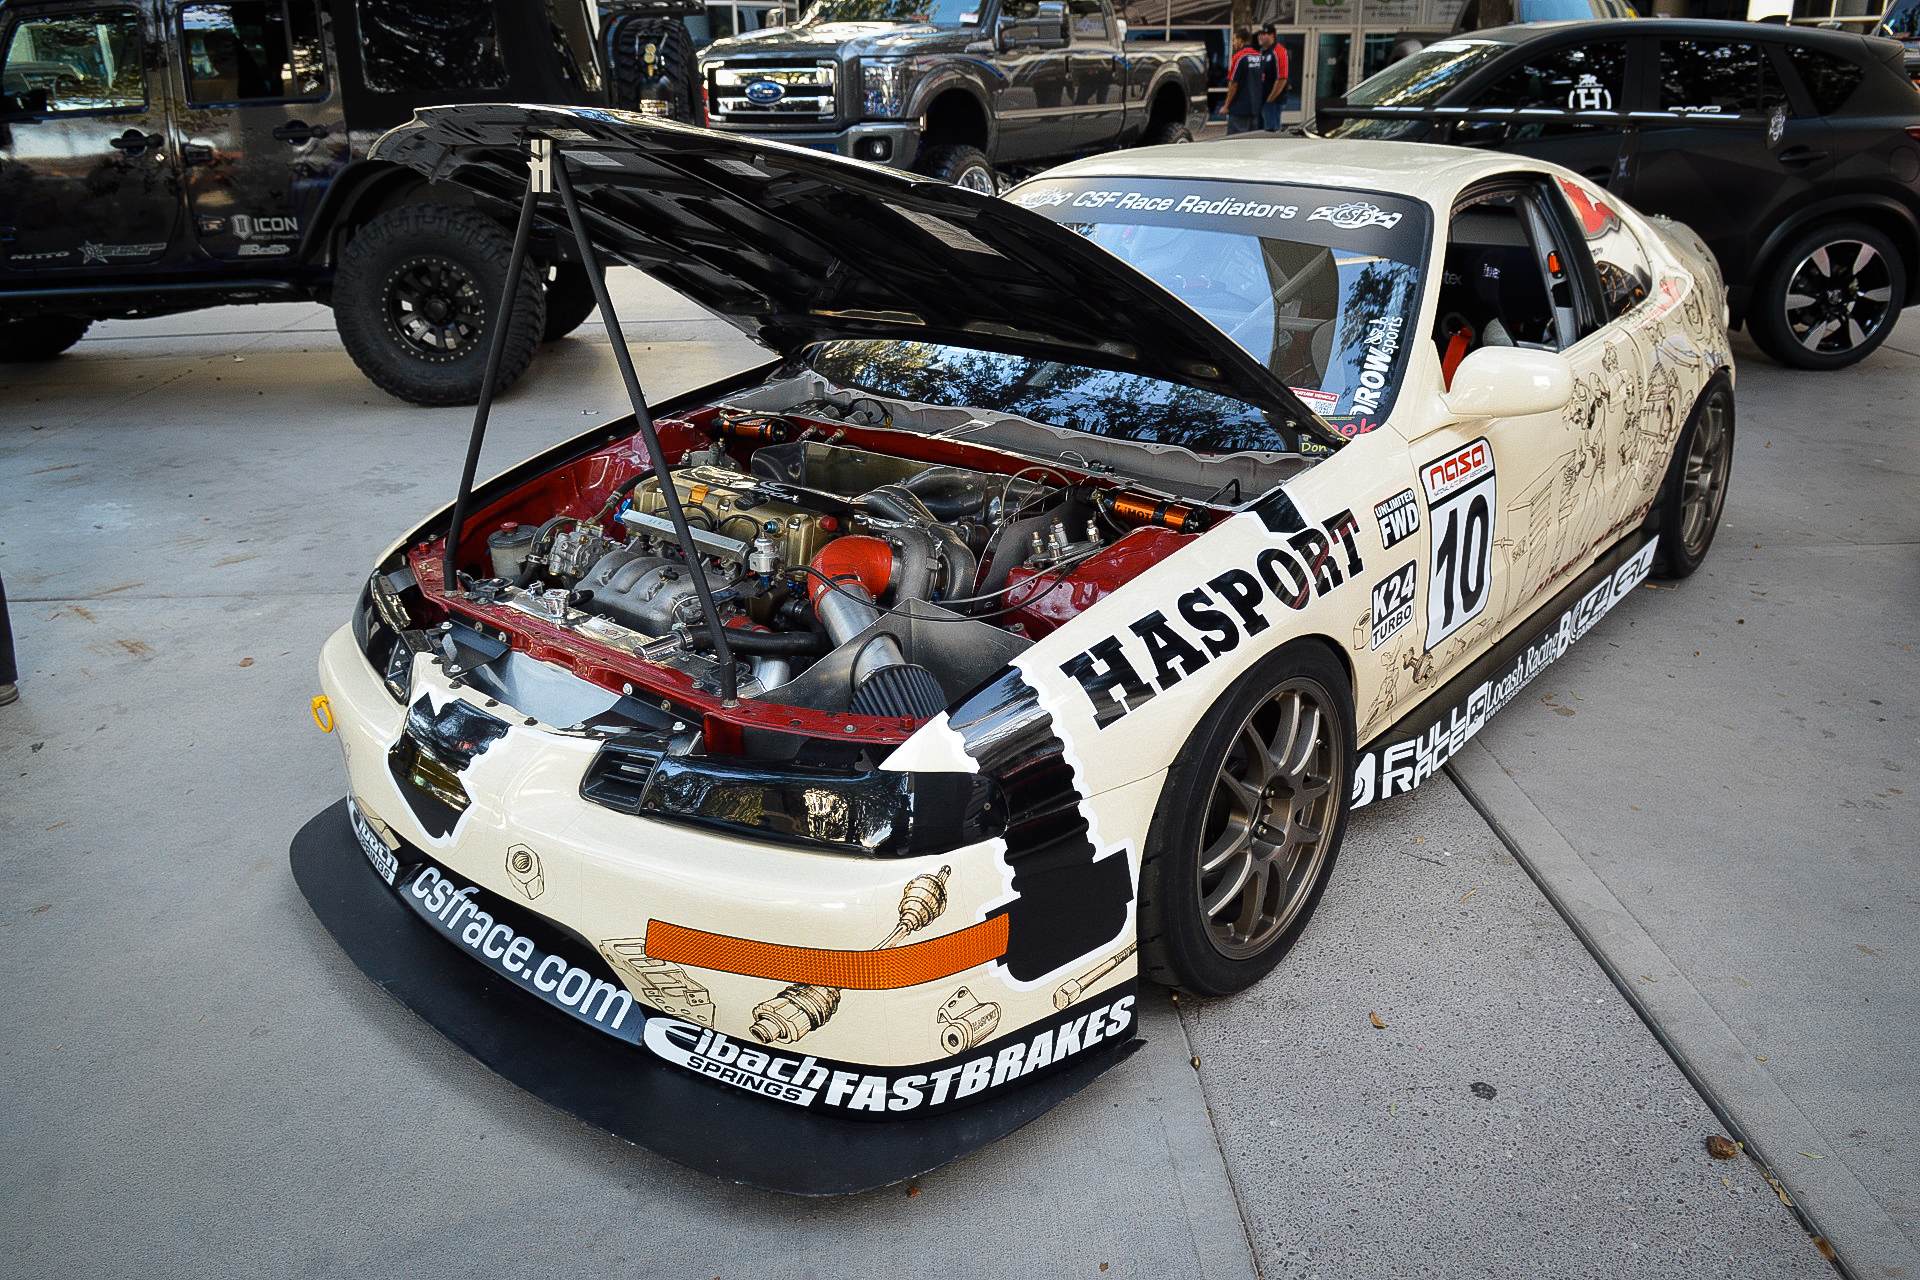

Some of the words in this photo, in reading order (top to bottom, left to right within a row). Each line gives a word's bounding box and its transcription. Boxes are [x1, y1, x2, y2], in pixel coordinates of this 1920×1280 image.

[253, 217, 298, 232] ICON
[1072, 191, 1123, 208] CSF
[1115, 192, 1175, 211] Race
[1175, 194, 1299, 219] Radiators
[1383, 316, 1403, 355] sports
[1430, 443, 1485, 490] nasa
[1375, 489, 1414, 518] UNLIMITED
[1378, 502, 1419, 548] FWD
[1436, 494, 1489, 630] 10
[1059, 508, 1364, 730] HASPORT
[1373, 565, 1414, 623] K24
[1372, 605, 1412, 647] TURBO
[1486, 655, 1524, 714] Locash
[1524, 633, 1559, 679] Racing
[1382, 732, 1465, 799] RACE
[1383, 706, 1467, 773] FULL
[411, 867, 633, 1030] csfrace.com
[644, 1017, 829, 1090] Eibach
[687, 1055, 802, 1101] SPRINGS
[824, 994, 1136, 1112] FASTBRAKES
